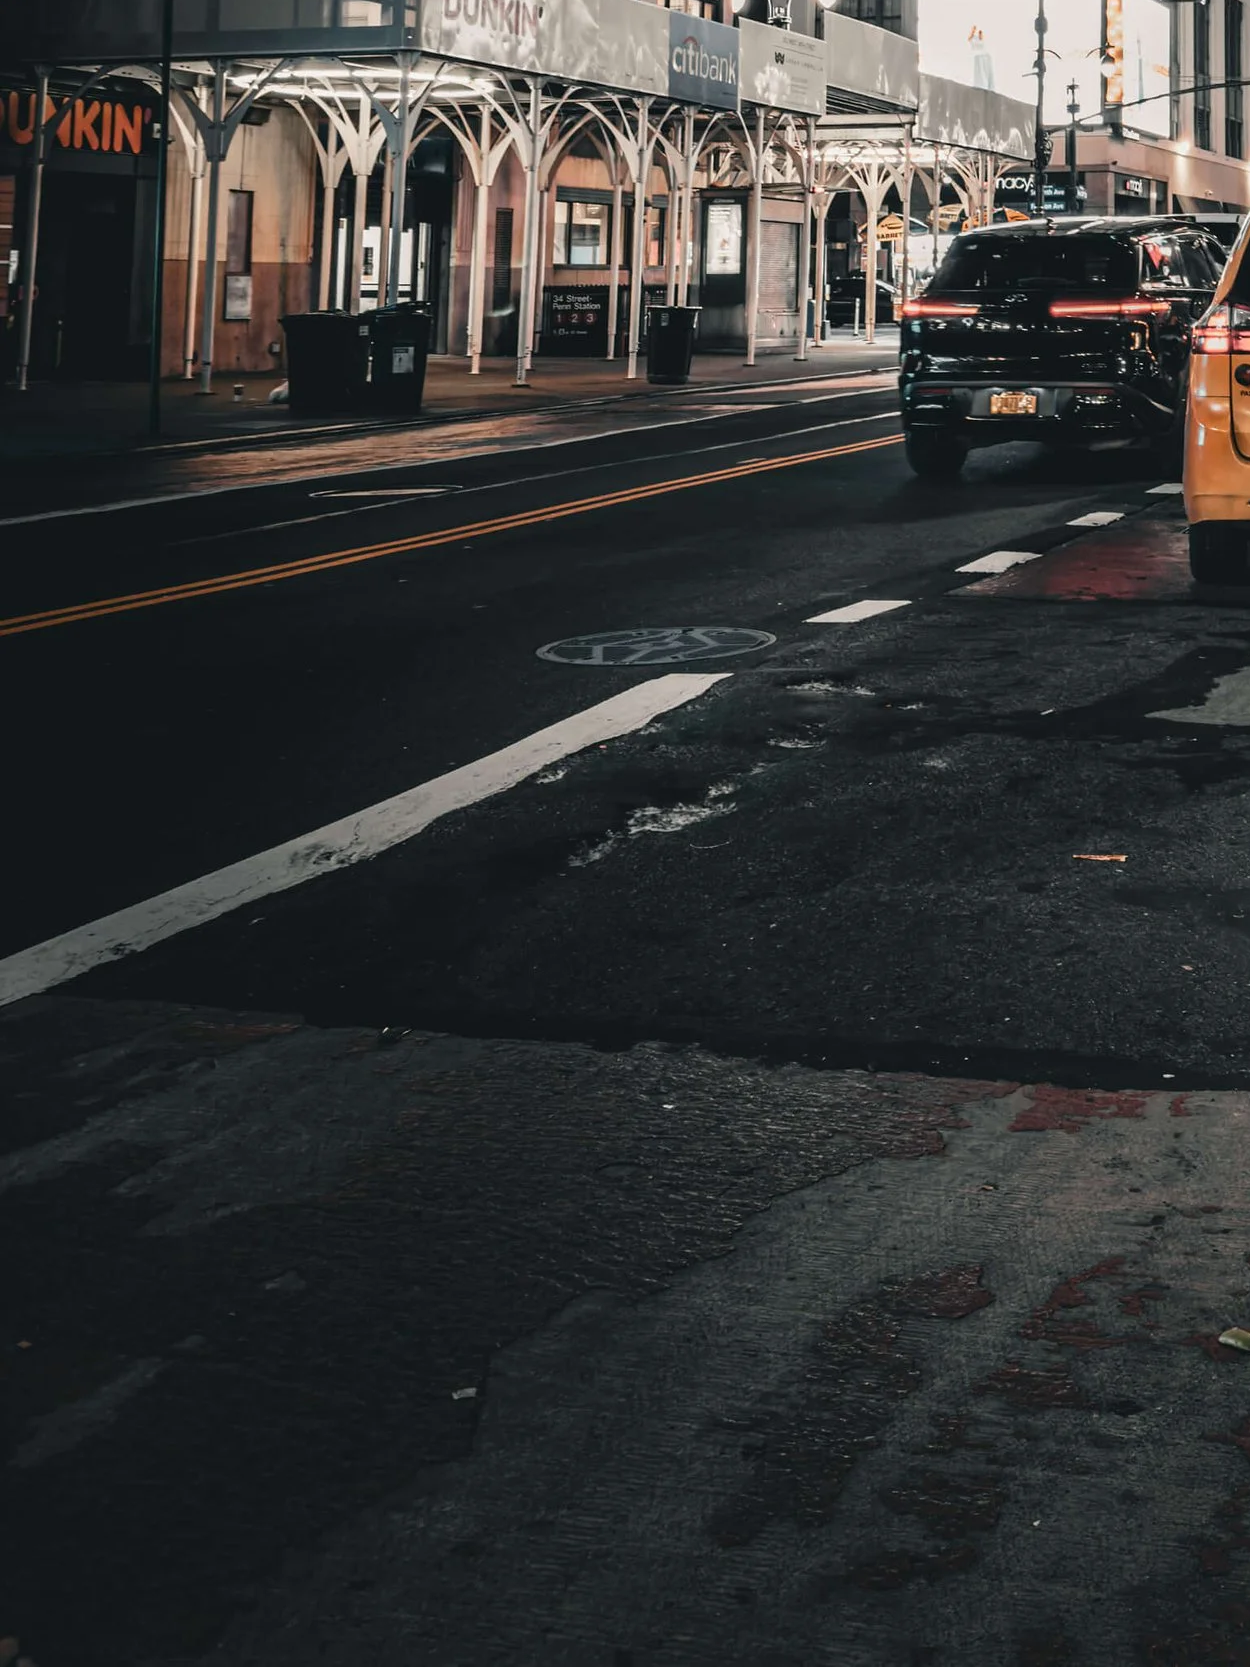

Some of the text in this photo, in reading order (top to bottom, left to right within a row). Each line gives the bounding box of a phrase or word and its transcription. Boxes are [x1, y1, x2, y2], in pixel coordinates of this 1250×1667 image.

[672, 44, 736, 85] citibank
[0, 91, 152, 154] UNKIN'
[552, 294, 563, 303] 34
